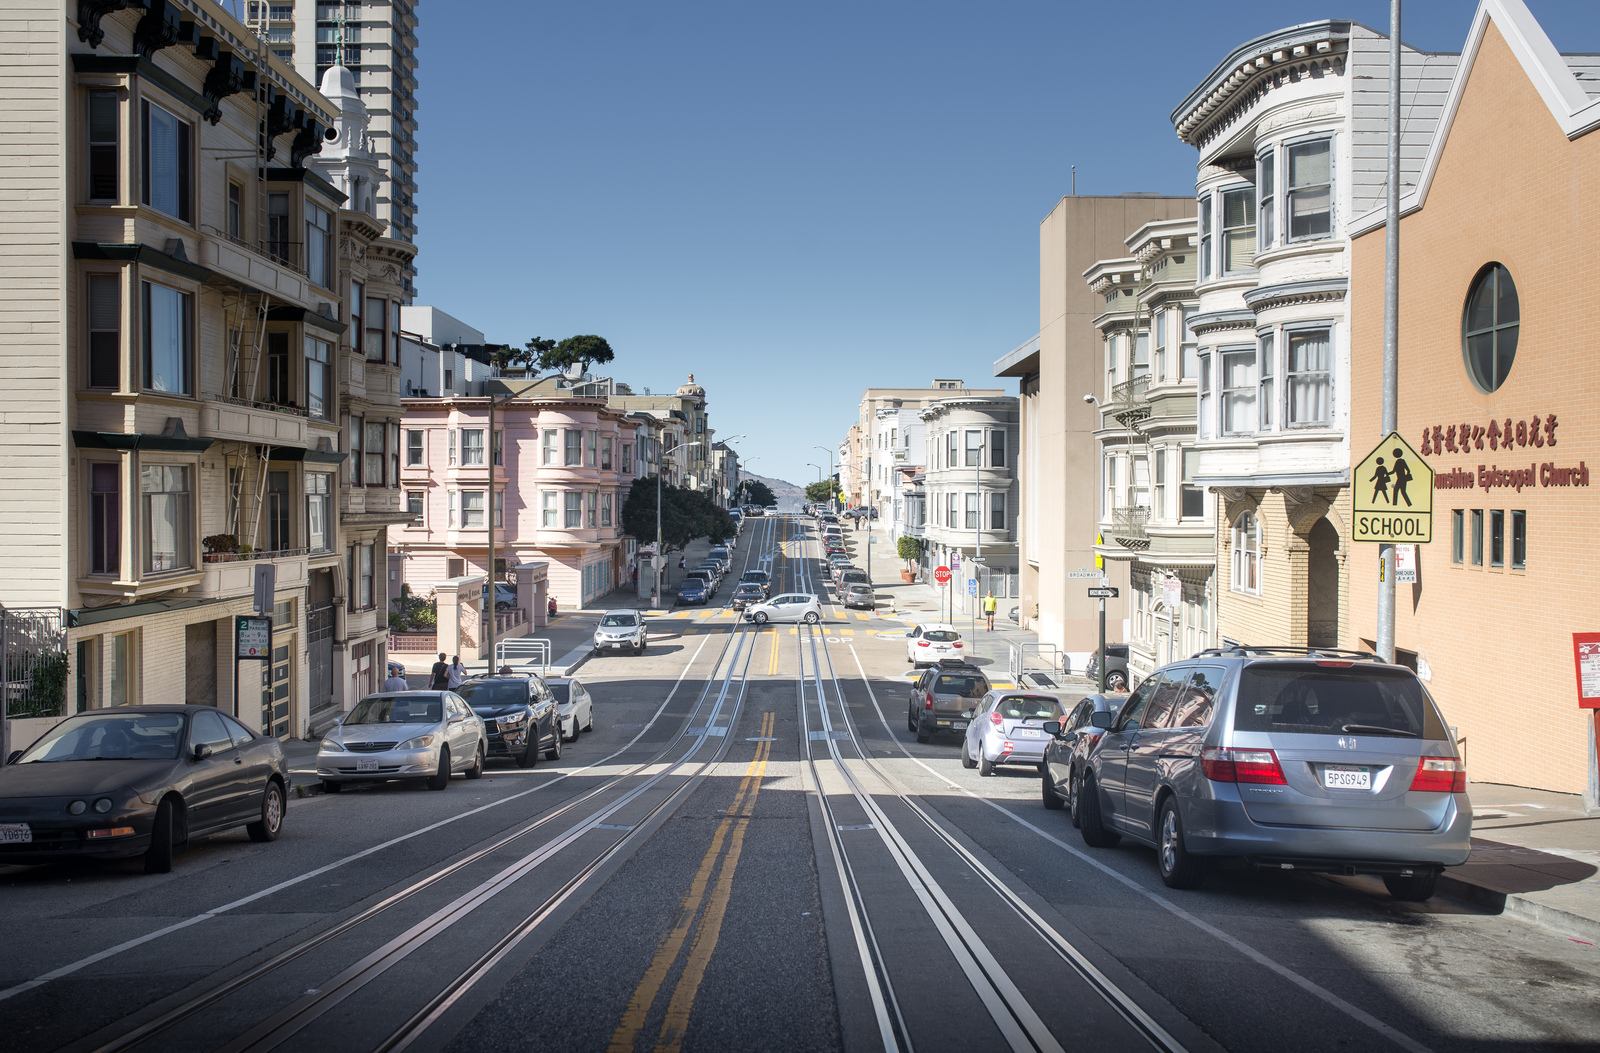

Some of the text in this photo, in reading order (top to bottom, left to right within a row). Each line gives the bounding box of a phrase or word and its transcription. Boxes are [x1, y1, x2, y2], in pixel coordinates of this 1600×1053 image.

[1435, 461, 1589, 493] unshine Episcopal Church
[1359, 516, 1425, 536] SCHOOL
[935, 570, 950, 578] STOP
[240, 620, 247, 629] 2
[800, 636, 854, 644] STOP
[1328, 773, 1368, 786] 5PSG949
